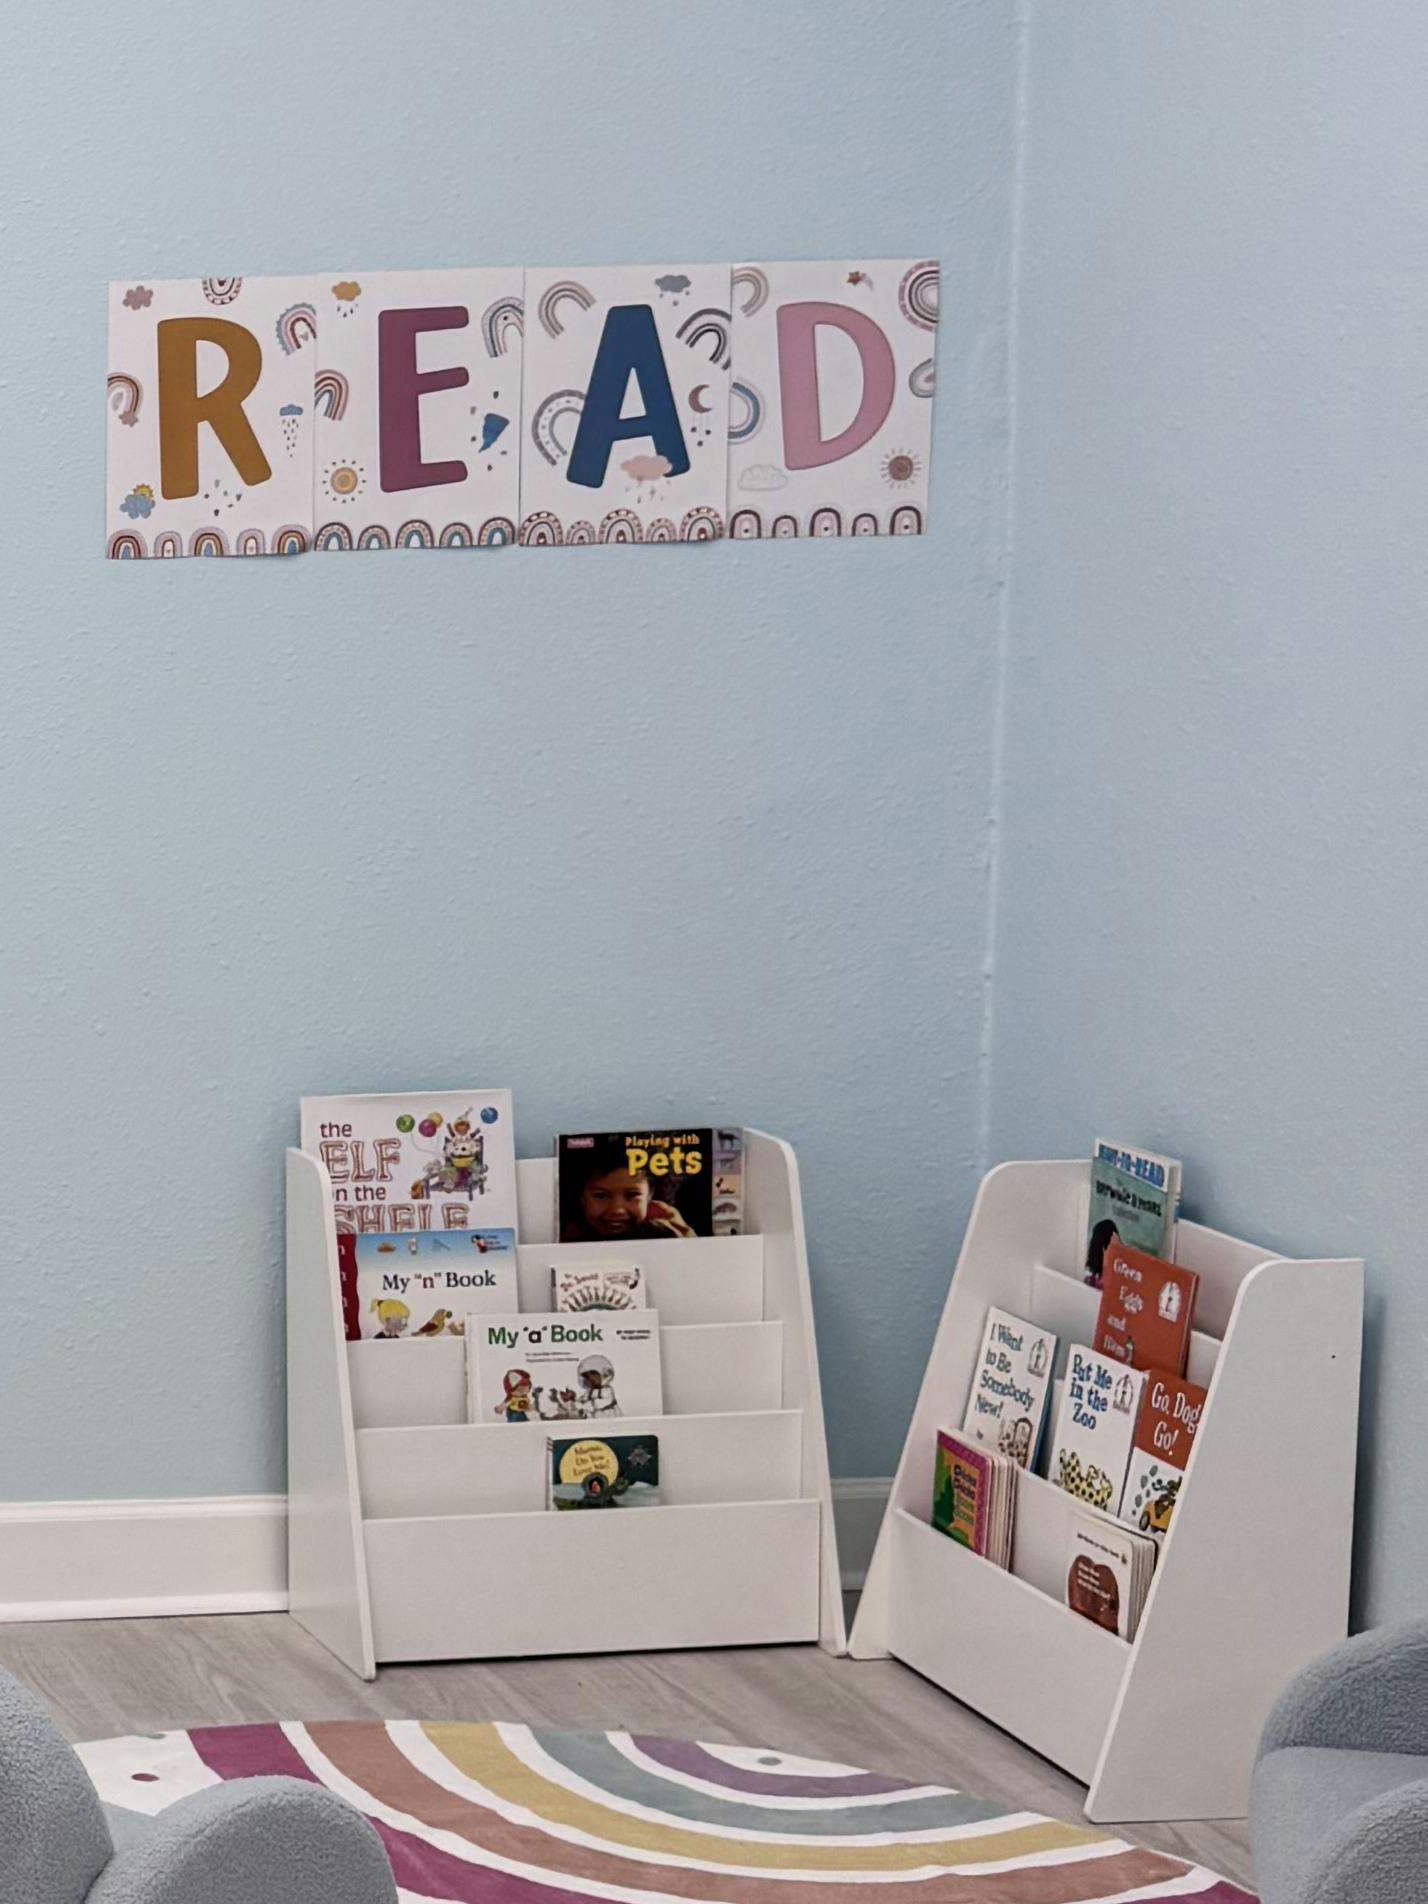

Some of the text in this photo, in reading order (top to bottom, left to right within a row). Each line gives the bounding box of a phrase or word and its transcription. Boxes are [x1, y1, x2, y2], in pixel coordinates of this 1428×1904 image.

[157, 300, 897, 500] READ
[320, 1122, 352, 1138] the
[625, 1133, 700, 1149] Playing with
[319, 1138, 400, 1184] ELF
[626, 1147, 702, 1177] Pets
[355, 1184, 386, 1200] the
[382, 1273, 411, 1294] My
[446, 1269, 496, 1288] Book
[488, 1326, 519, 1348] My
[551, 1323, 603, 1343] Book
[997, 1323, 1024, 1352] Want
[985, 1348, 1012, 1374] to Be
[1072, 1353, 1113, 1390] Put Me
[980, 1368, 1036, 1413] Somebody
[1070, 1377, 1108, 1412] in the
[974, 1393, 1004, 1419] New!
[1072, 1403, 1097, 1430] Zoo
[1153, 1421, 1180, 1457] Go!
